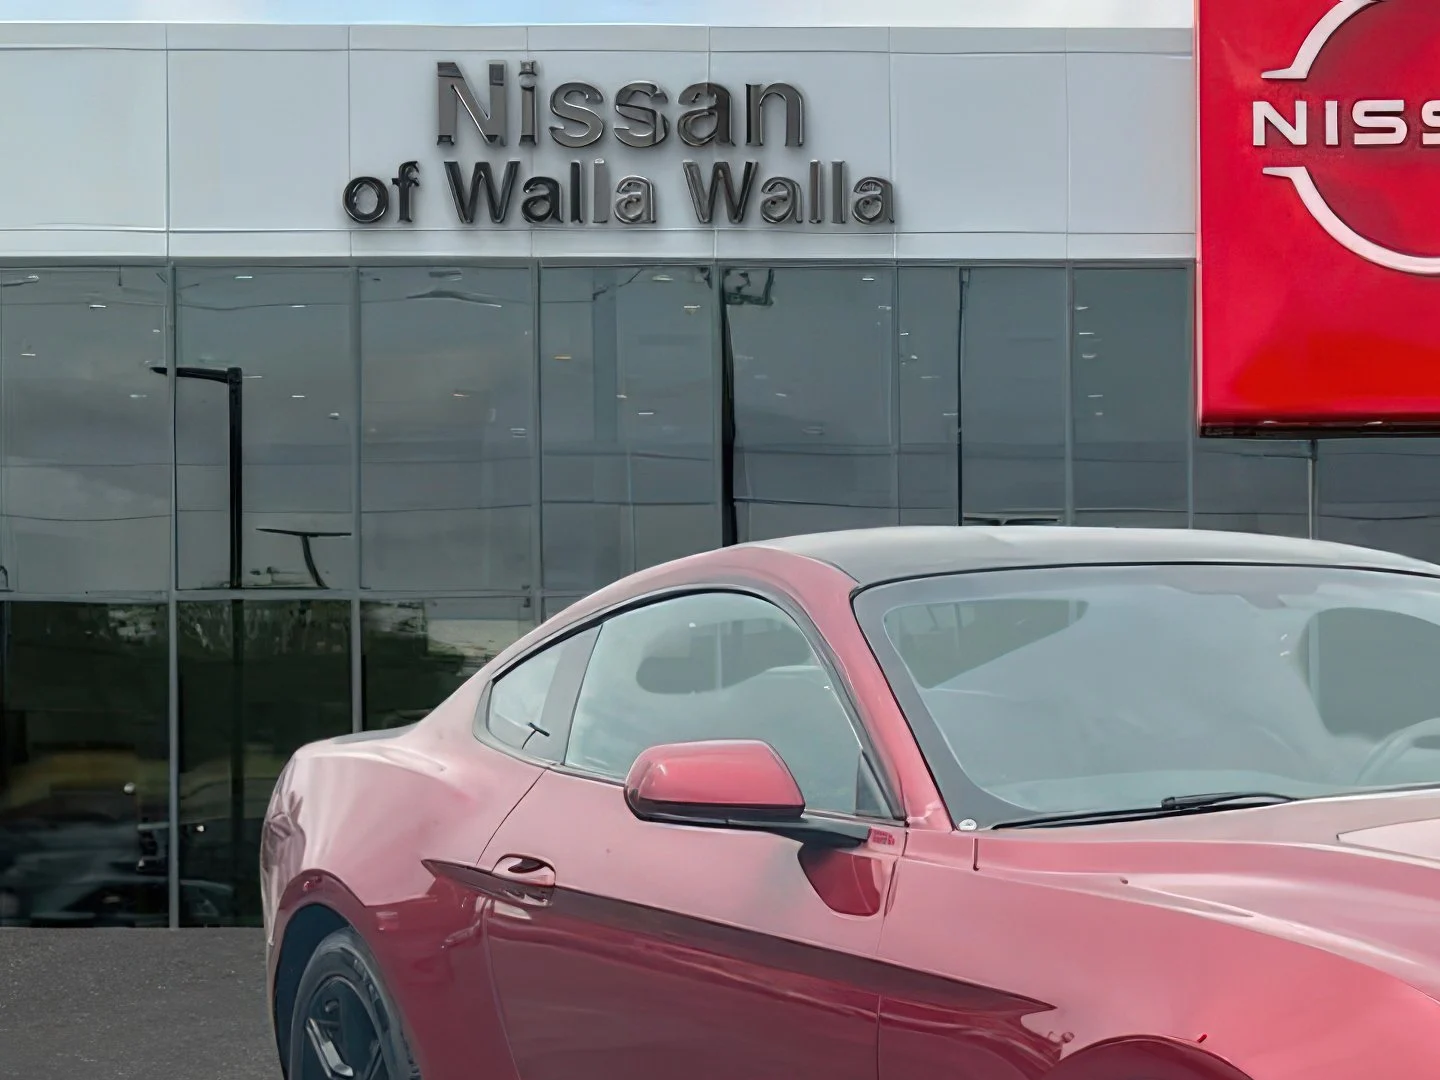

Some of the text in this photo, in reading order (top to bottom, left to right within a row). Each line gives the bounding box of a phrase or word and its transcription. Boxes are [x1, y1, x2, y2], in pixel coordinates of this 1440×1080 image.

[437, 60, 804, 147] Nissan
[342, 159, 895, 224] of Walla Walla
